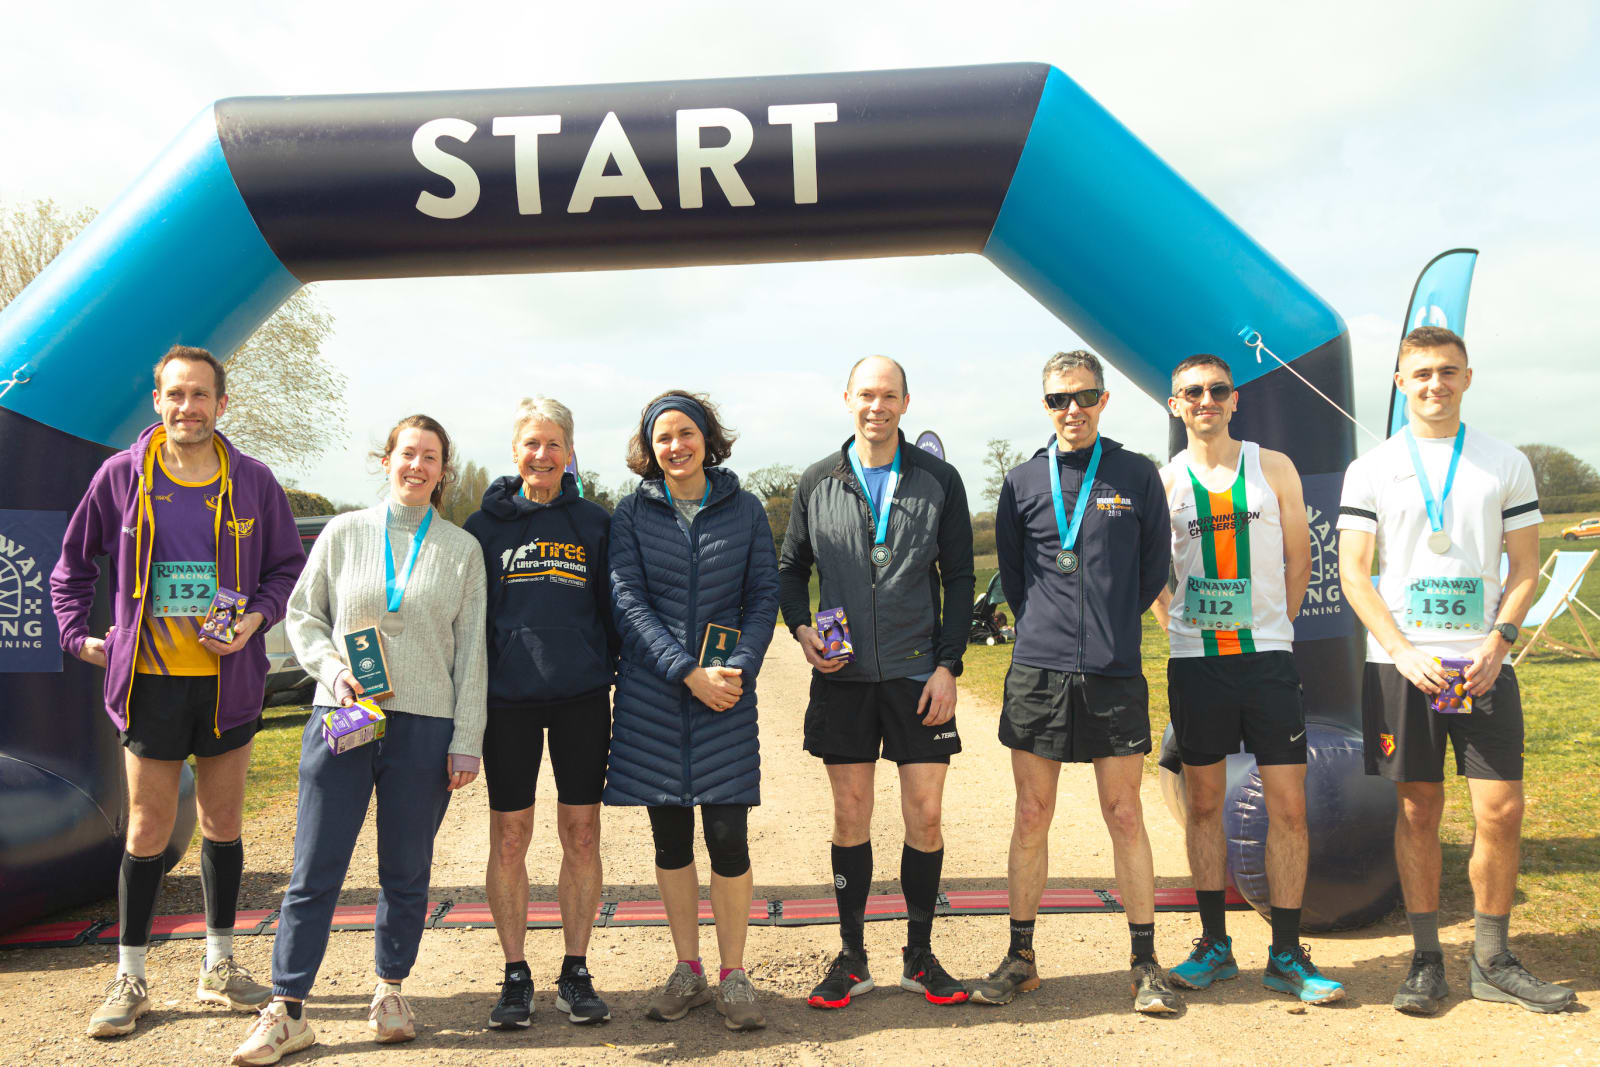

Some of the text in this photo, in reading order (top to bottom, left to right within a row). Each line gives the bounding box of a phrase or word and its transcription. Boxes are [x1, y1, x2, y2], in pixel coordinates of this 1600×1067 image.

[411, 102, 838, 219] START
[1188, 511, 1260, 529] MORNINGTON
[1189, 523, 1236, 537] CHASERS
[536, 541, 586, 562] Tiree
[516, 559, 587, 573] ultra-marathon
[168, 583, 210, 599] 132
[1188, 577, 1247, 594] RUNAWAY
[1200, 589, 1236, 597] RACING
[1410, 578, 1479, 593] RUNAWAY
[1426, 588, 1467, 596] RACING
[1198, 598, 1233, 615] 112
[1422, 598, 1466, 616] 136
[354, 635, 370, 651] 3
[716, 632, 727, 650] 1
